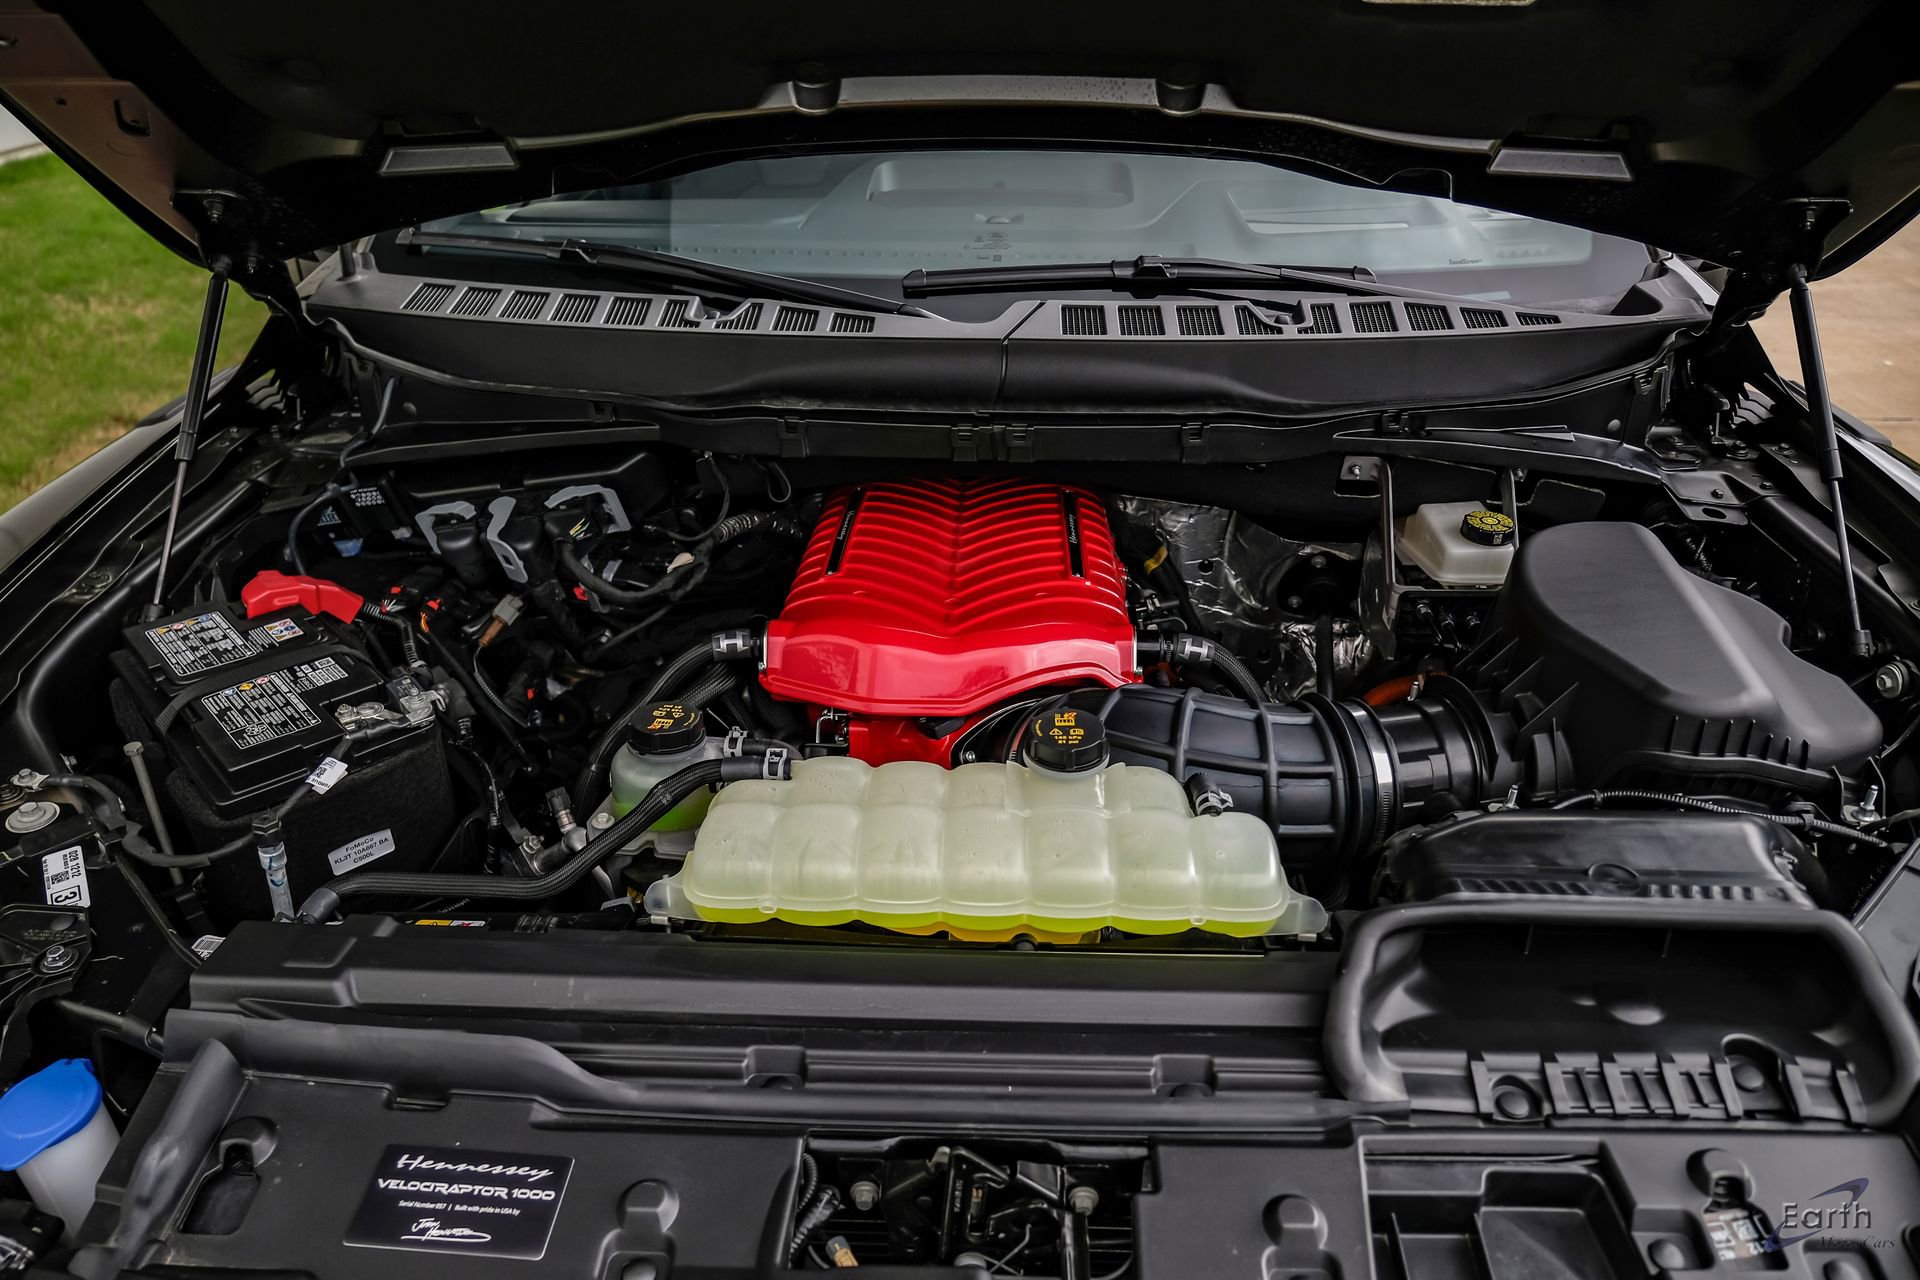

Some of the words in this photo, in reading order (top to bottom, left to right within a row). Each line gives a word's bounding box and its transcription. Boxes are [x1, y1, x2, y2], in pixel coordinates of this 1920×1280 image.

[345, 837, 374, 852] FoMoCo
[53, 891, 77, 903] 3
[396, 1153, 554, 1182] Hennessey
[376, 1177, 508, 1200] VELOCIRAPTOR
[511, 1188, 556, 1201] 1000
[398, 1200, 414, 1208] Serial
[414, 1201, 436, 1209] Number
[479, 1206, 494, 1214] pride
[500, 1207, 512, 1215] USA
[512, 1208, 520, 1216] by
